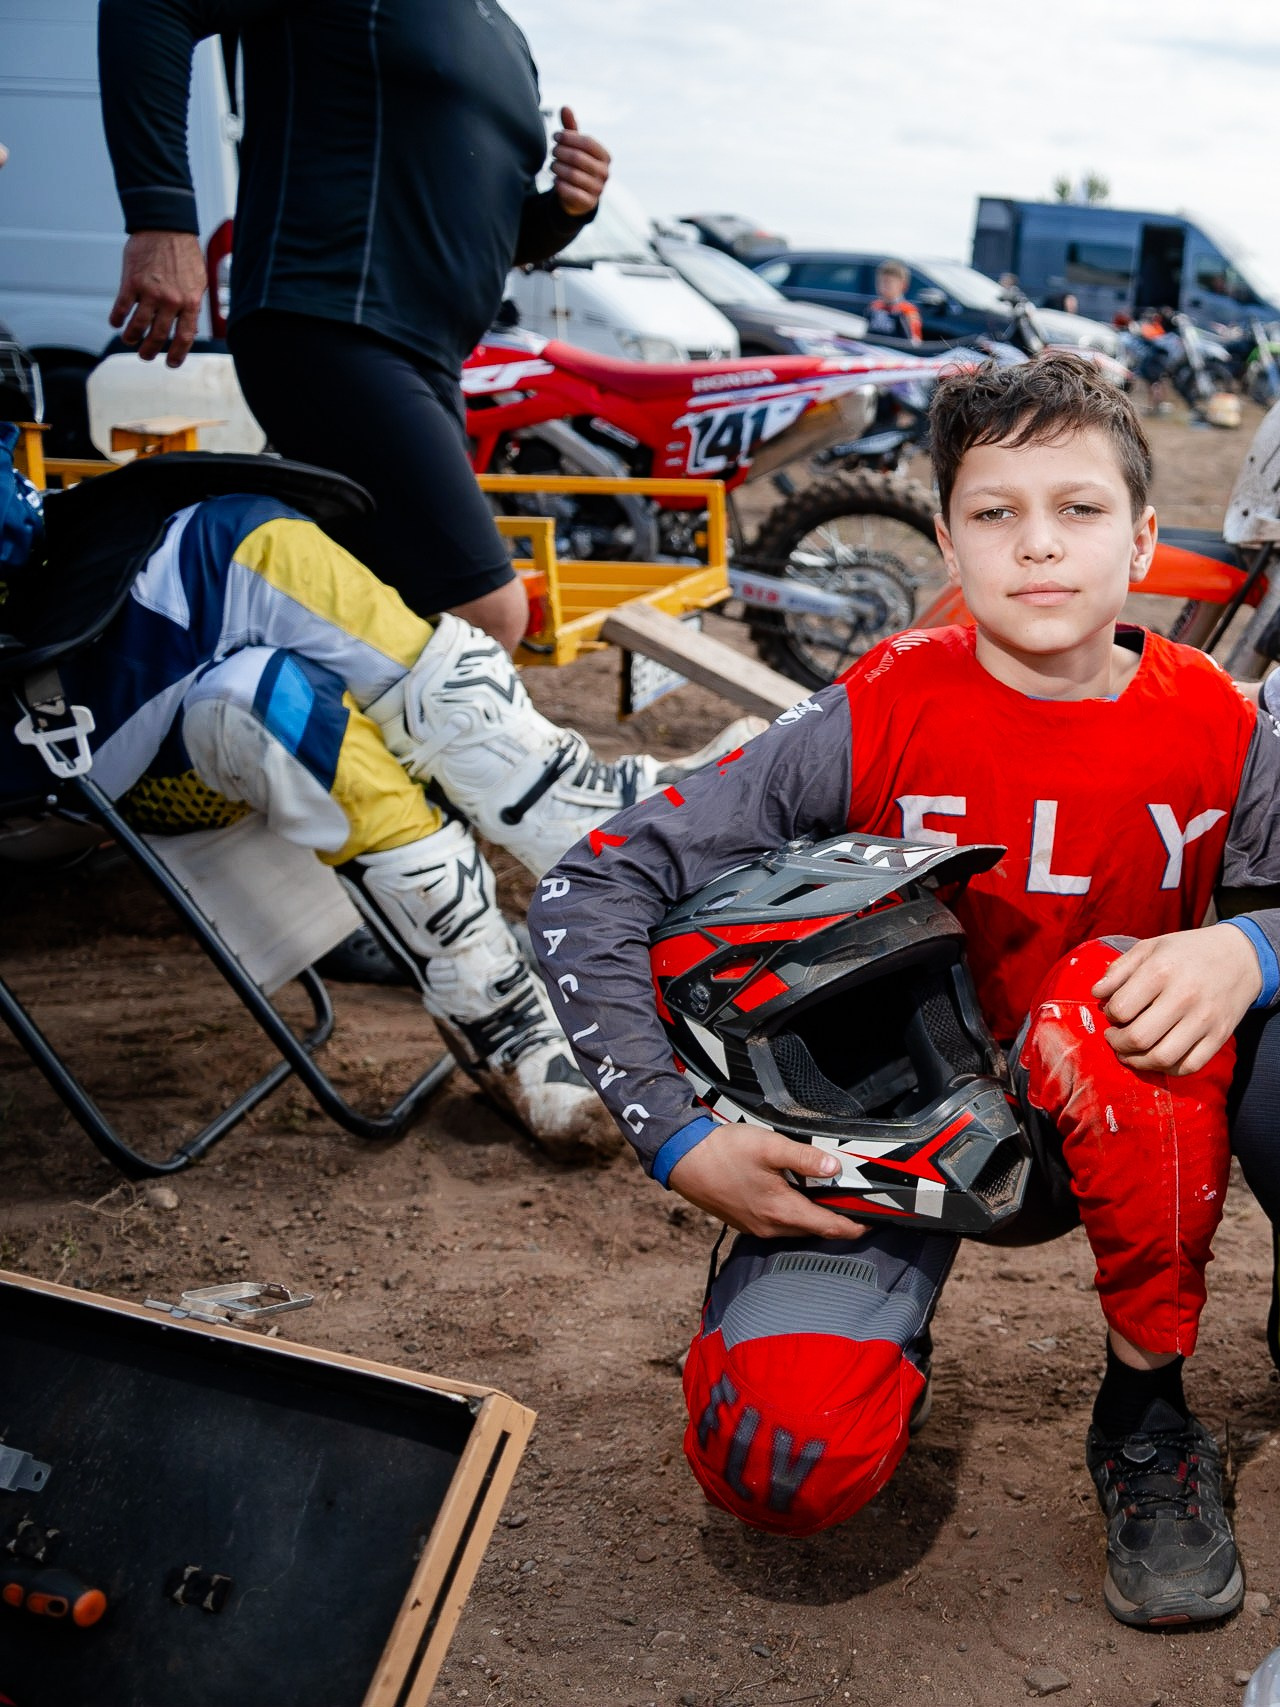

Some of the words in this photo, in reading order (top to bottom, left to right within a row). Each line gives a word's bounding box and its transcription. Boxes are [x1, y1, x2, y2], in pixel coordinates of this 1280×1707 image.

[692, 370, 777, 393] HONDA
[690, 406, 770, 470] 141
[895, 794, 1228, 896] FLY
[542, 876, 651, 1136] RACING
[697, 1372, 828, 1513] FLY
